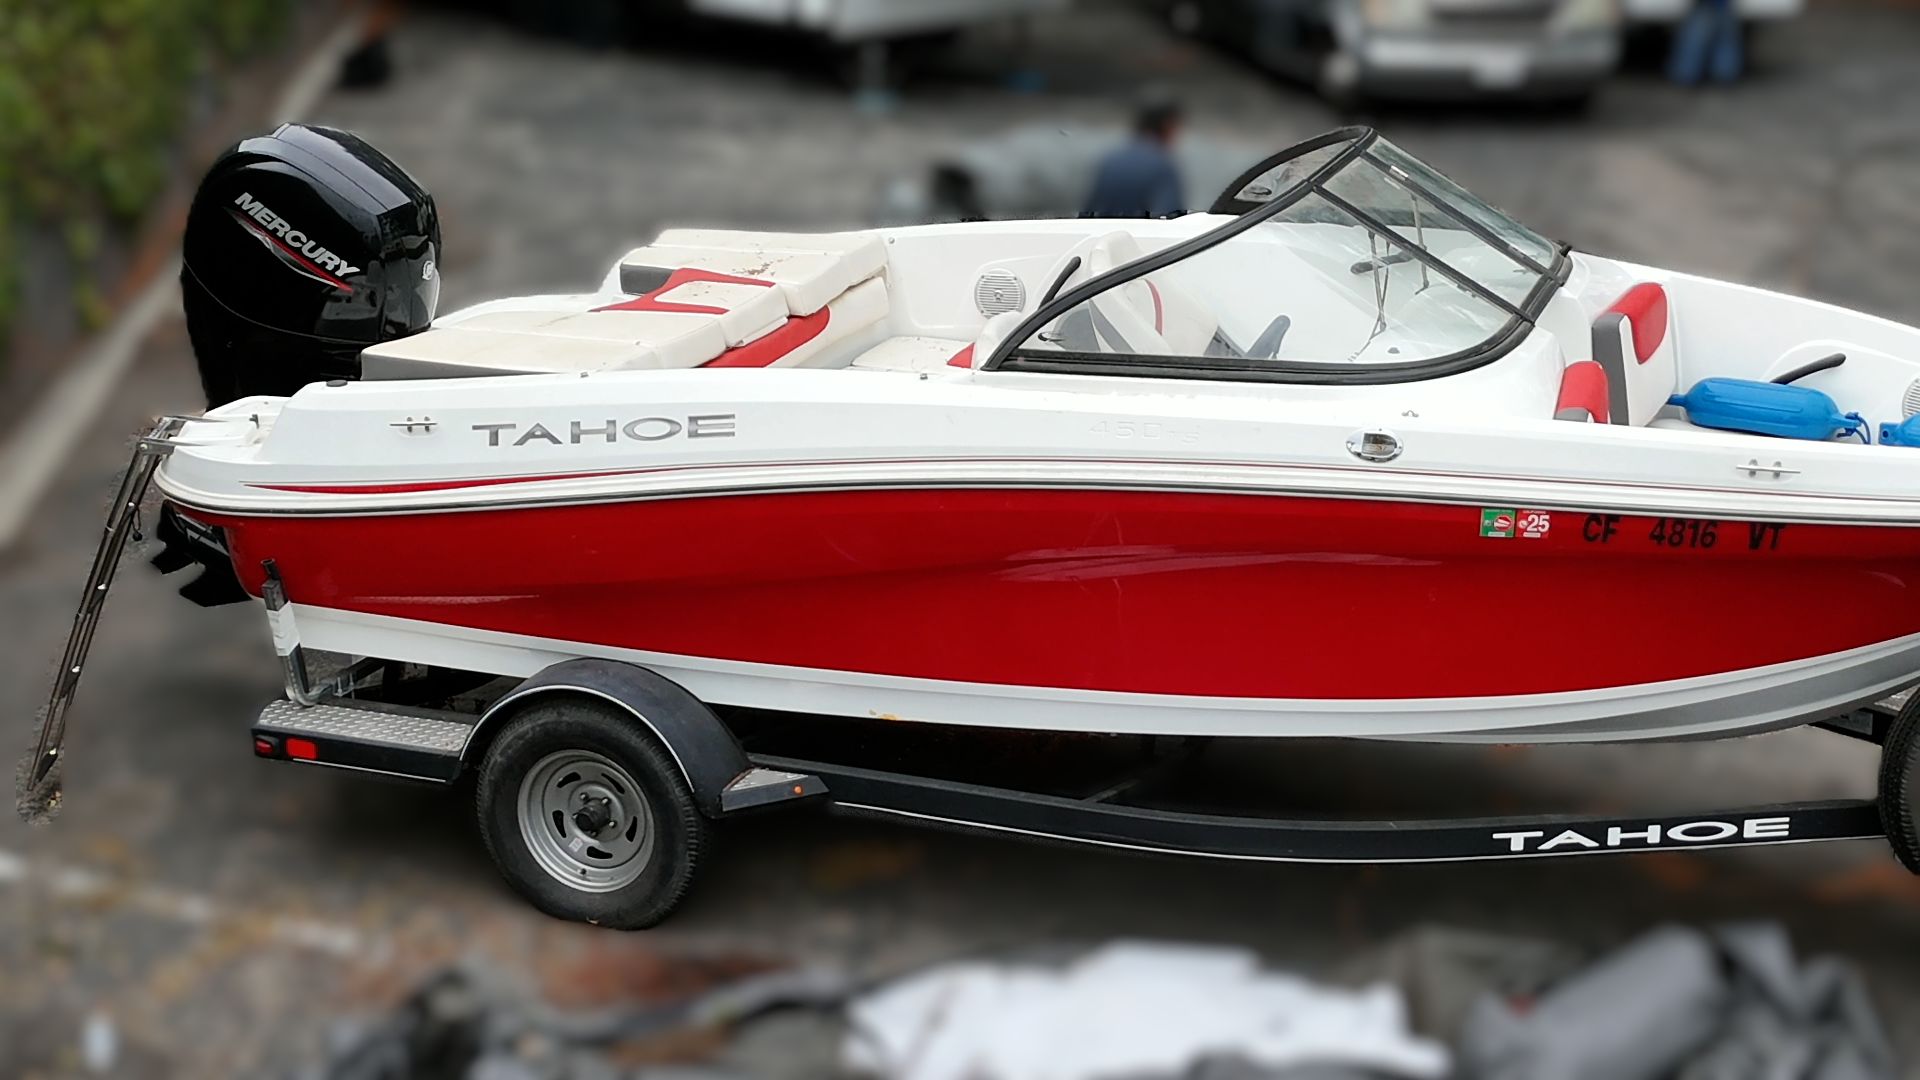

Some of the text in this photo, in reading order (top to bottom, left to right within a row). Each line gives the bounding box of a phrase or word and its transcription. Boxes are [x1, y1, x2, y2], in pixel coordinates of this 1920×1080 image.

[234, 192, 360, 277] MERCURY
[471, 413, 736, 447] TAHOE
[1526, 513, 1551, 533] 25
[1582, 513, 1786, 550] CF 4816 VT
[1492, 816, 1791, 852] TAHOE
